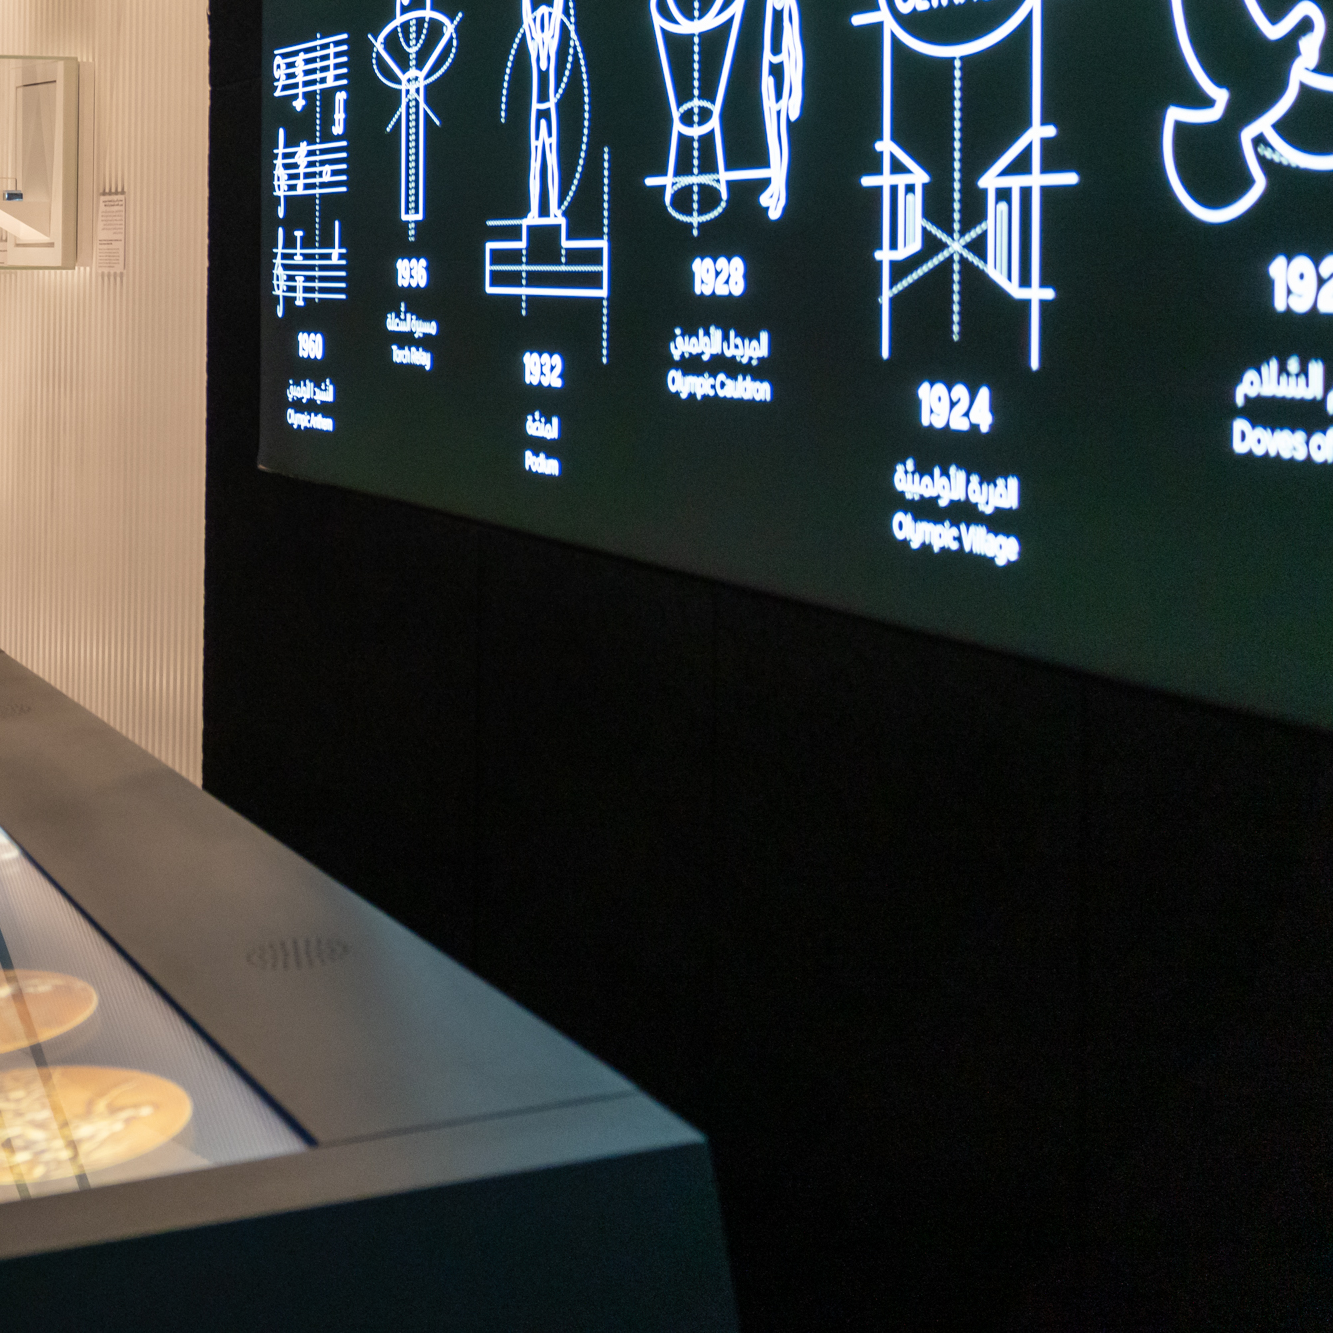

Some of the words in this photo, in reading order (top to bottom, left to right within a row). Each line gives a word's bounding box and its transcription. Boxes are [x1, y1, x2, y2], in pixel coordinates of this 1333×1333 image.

[396, 257, 428, 288] 1936
[692, 256, 745, 297] 1928
[298, 332, 324, 360] 1960
[391, 344, 411, 365] Torch
[410, 347, 432, 370] Relay
[523, 351, 564, 388] 1932
[667, 368, 716, 400] Olympic
[715, 372, 772, 402] Cauldron
[287, 408, 310, 430] Olympic
[310, 413, 334, 431] Anthem
[917, 381, 994, 434] 1924
[1232, 417, 1309, 462] Doves
[525, 450, 561, 476] Podium
[967, 473, 1019, 515] القرية
[892, 510, 960, 554] Olympic
[959, 521, 1020, 566] Village
